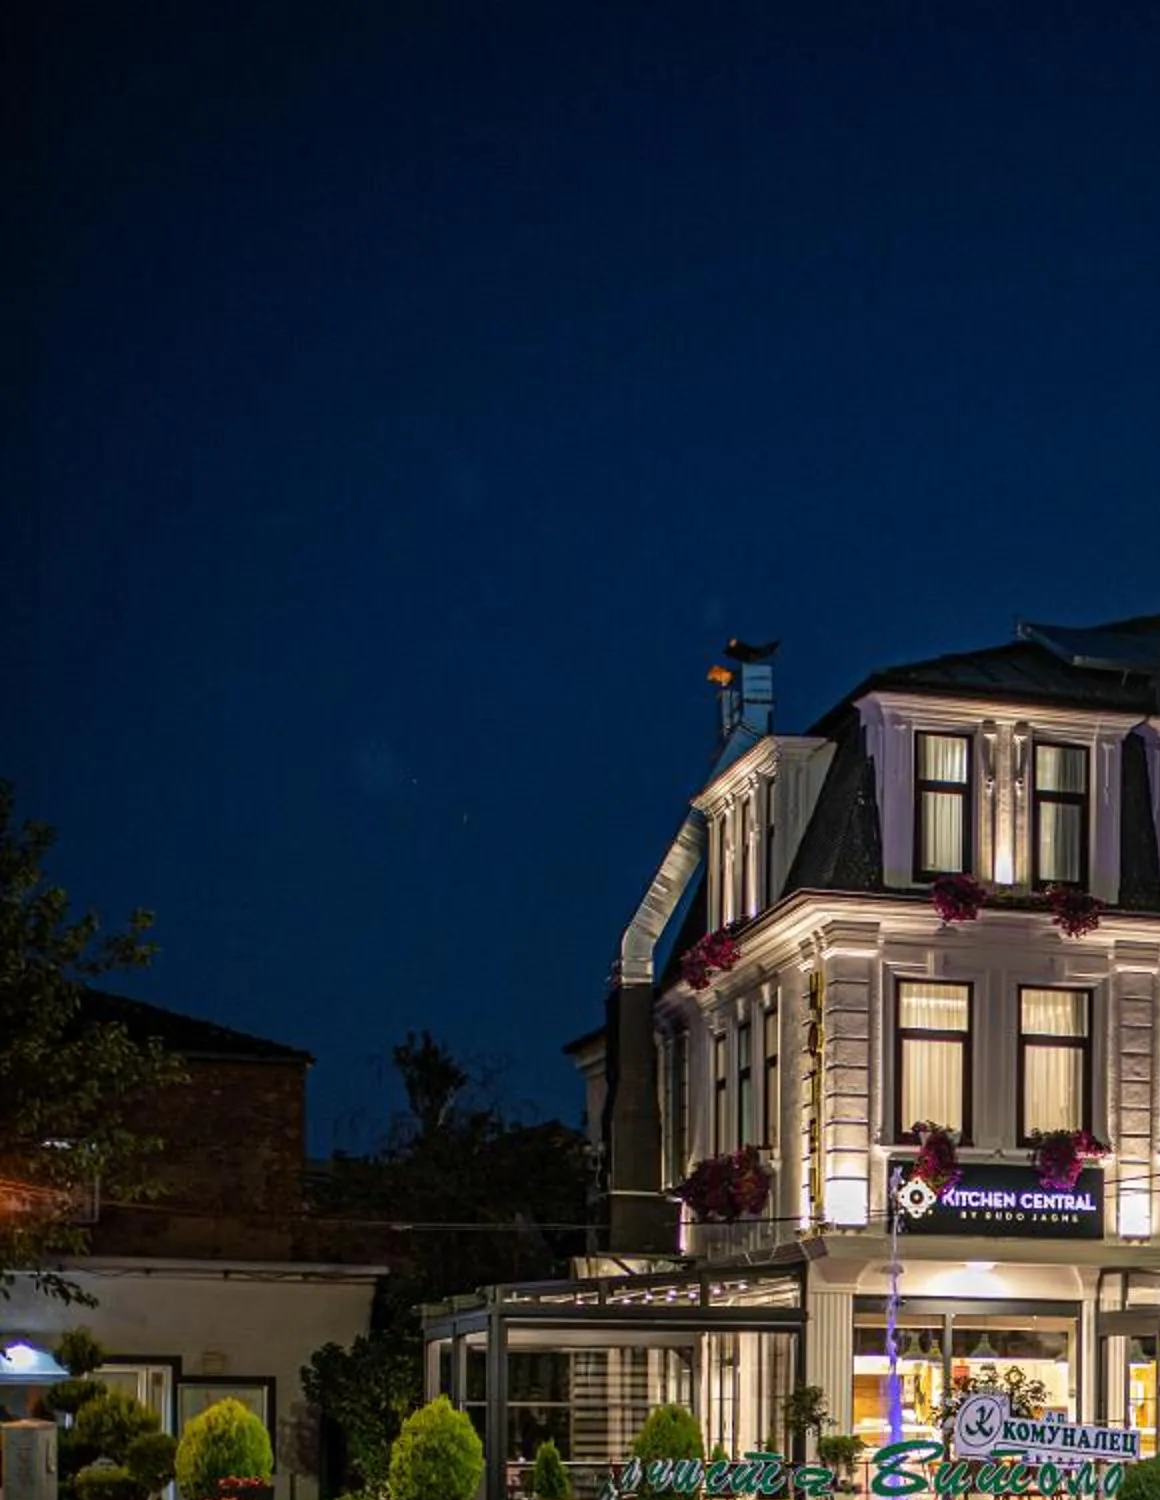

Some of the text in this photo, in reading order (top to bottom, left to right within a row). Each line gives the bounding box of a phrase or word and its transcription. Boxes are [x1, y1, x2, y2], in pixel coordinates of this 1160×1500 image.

[942, 1188, 1097, 1211] KITCHEN CENTRAL
[1002, 1420, 1137, 1456] КОМУНАЛЕЦ
